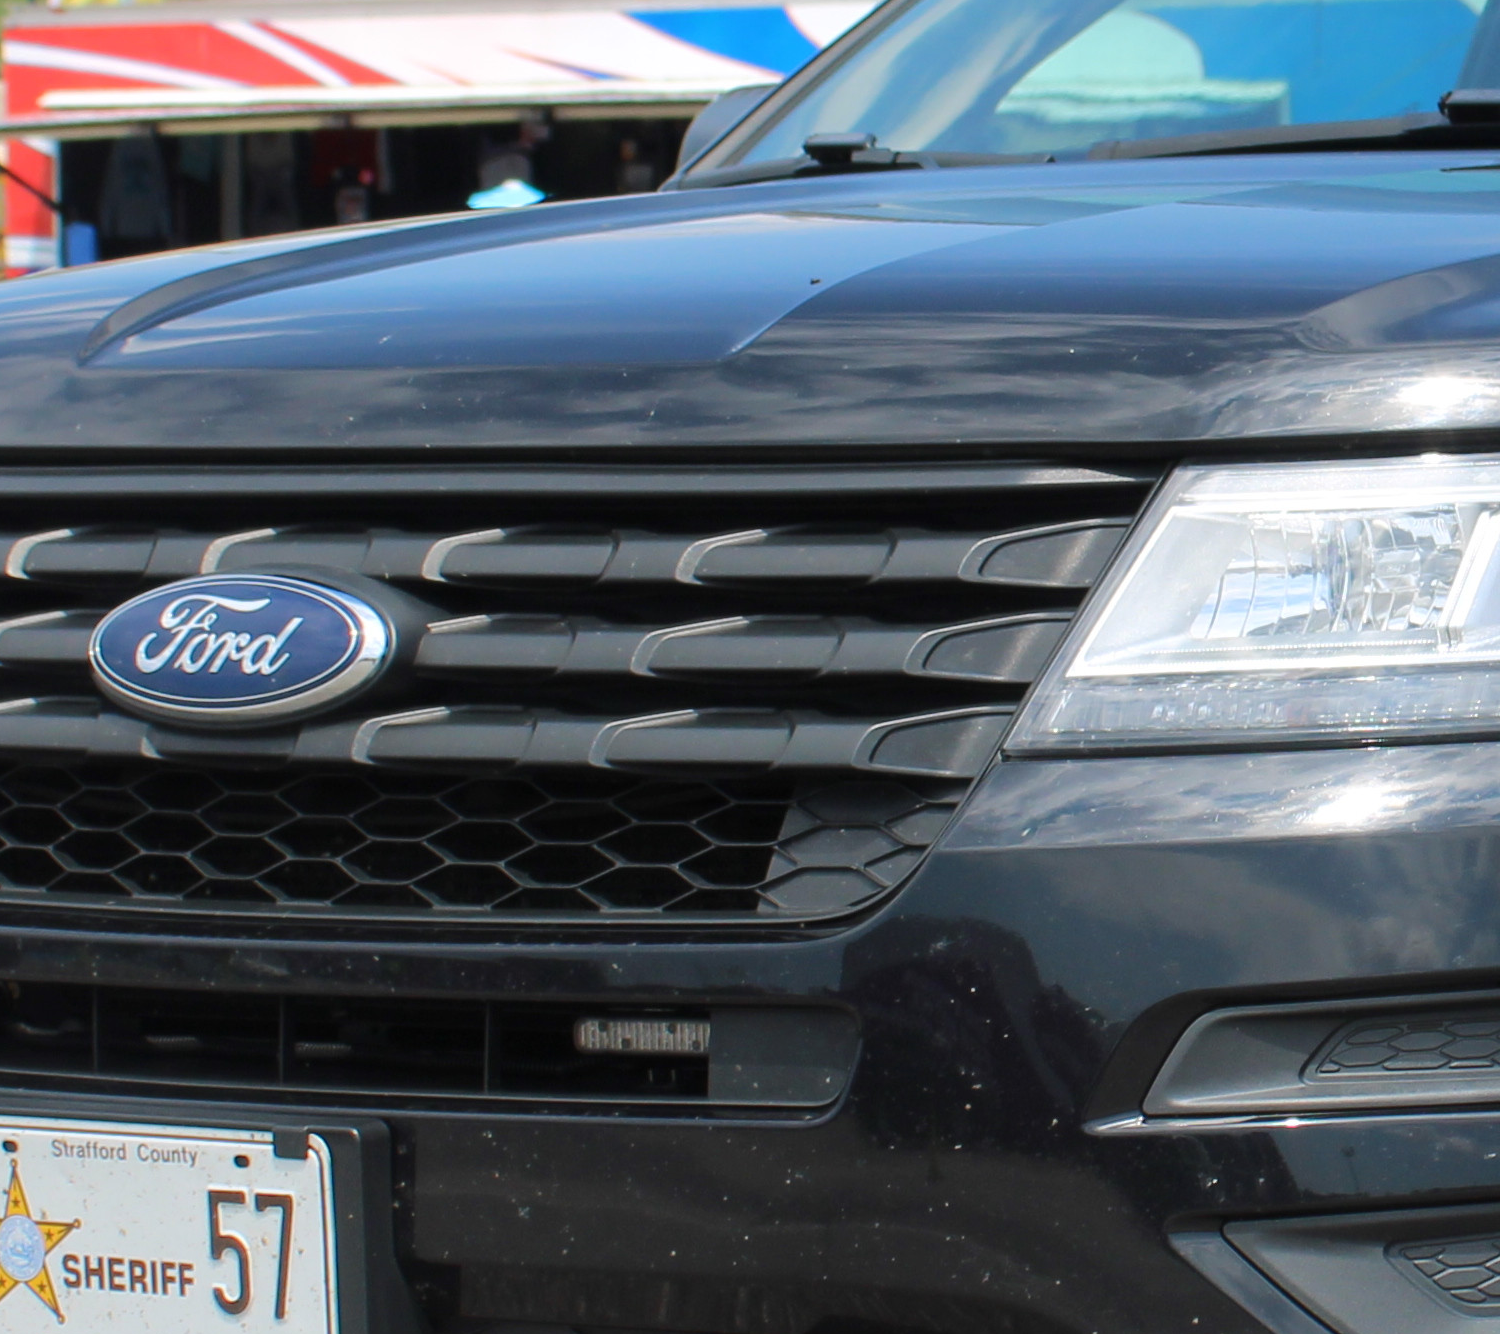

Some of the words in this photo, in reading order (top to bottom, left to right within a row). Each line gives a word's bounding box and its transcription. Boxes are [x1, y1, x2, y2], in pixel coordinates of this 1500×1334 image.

[135, 594, 303, 675] Ford
[51, 1139, 127, 1162] Strafford
[137, 1143, 198, 1167] County
[62, 1253, 195, 1297] SHERIFF
[206, 1189, 295, 1320] 57
